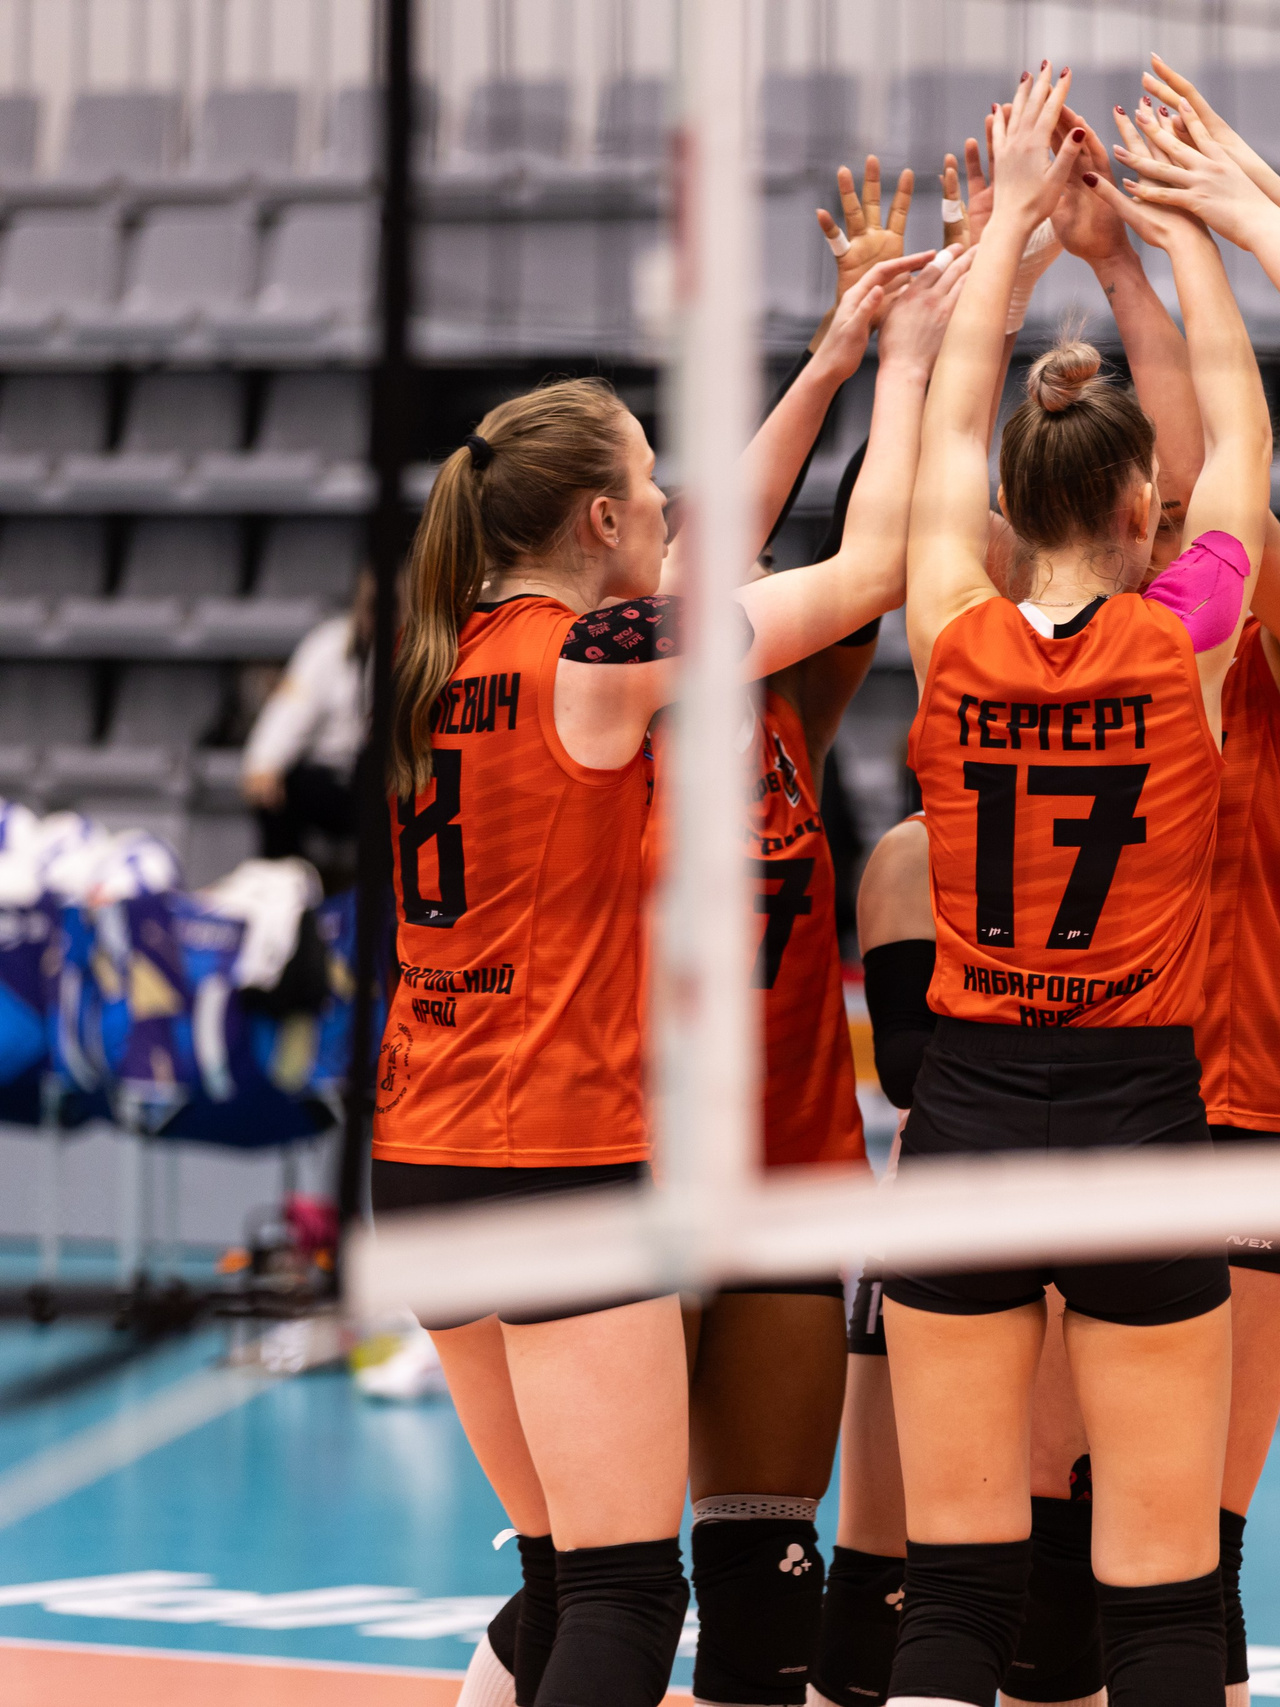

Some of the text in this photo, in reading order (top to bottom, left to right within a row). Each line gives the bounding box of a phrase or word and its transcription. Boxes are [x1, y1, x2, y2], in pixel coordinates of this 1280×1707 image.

[621, 635, 646, 650] TAPE
[957, 693, 1153, 751] ГЕРГЕРТ
[398, 748, 468, 929] 8
[962, 760, 1151, 950] 17
